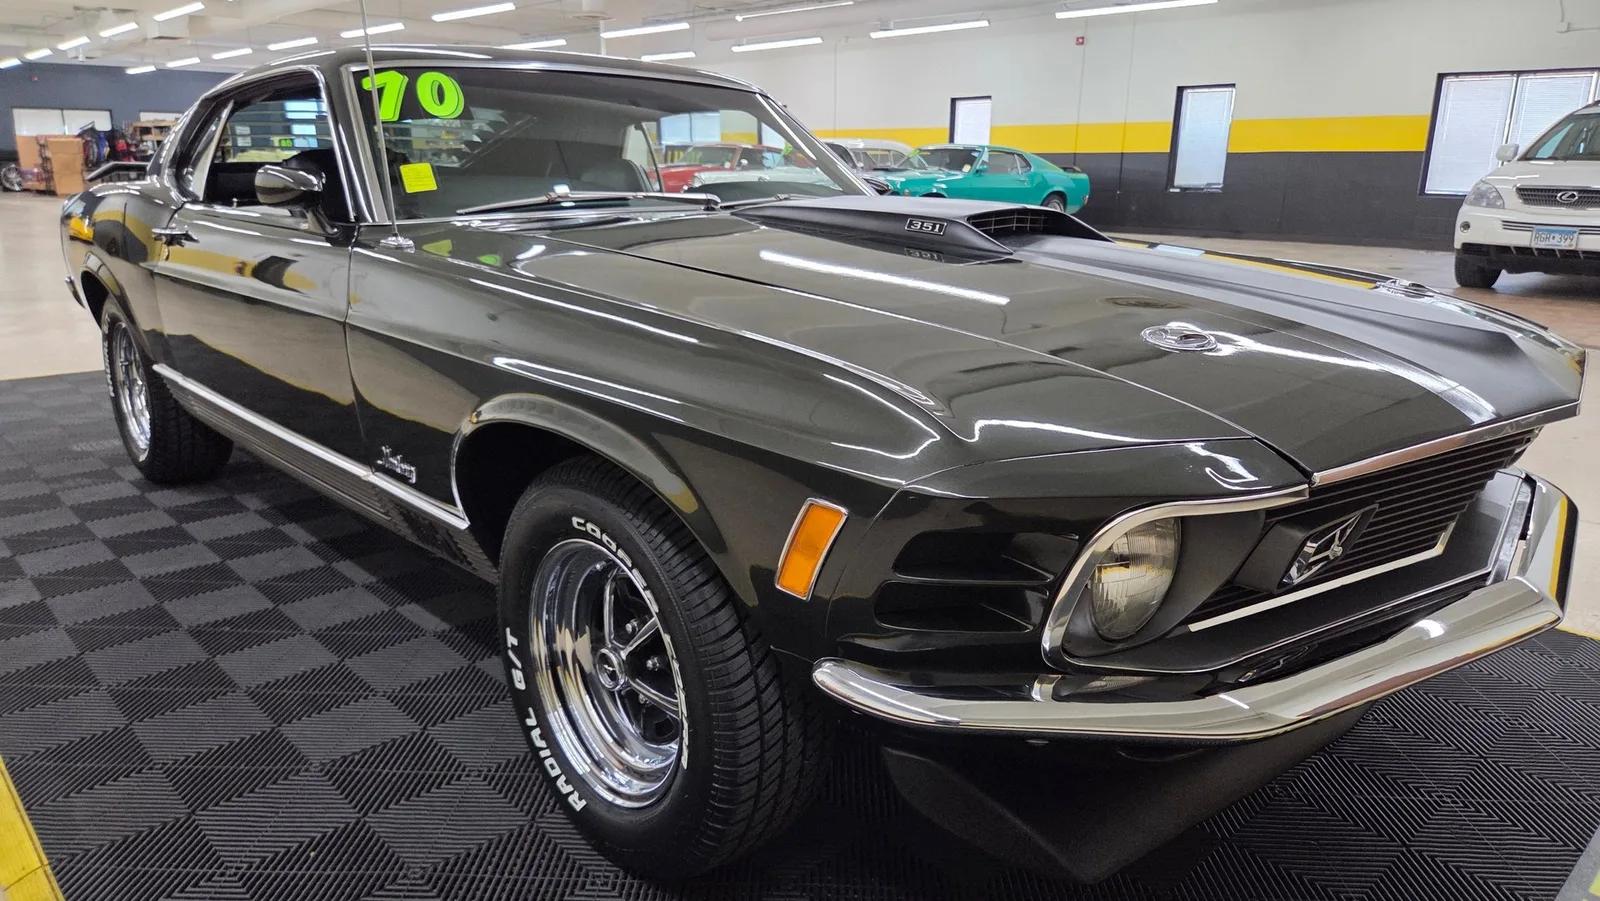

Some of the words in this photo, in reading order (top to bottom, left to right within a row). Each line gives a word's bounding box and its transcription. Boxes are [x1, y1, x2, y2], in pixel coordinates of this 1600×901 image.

[362, 70, 464, 122] 70
[911, 221, 940, 232] 351
[505, 627, 526, 690] G/T
[525, 707, 587, 811] RADIAL
